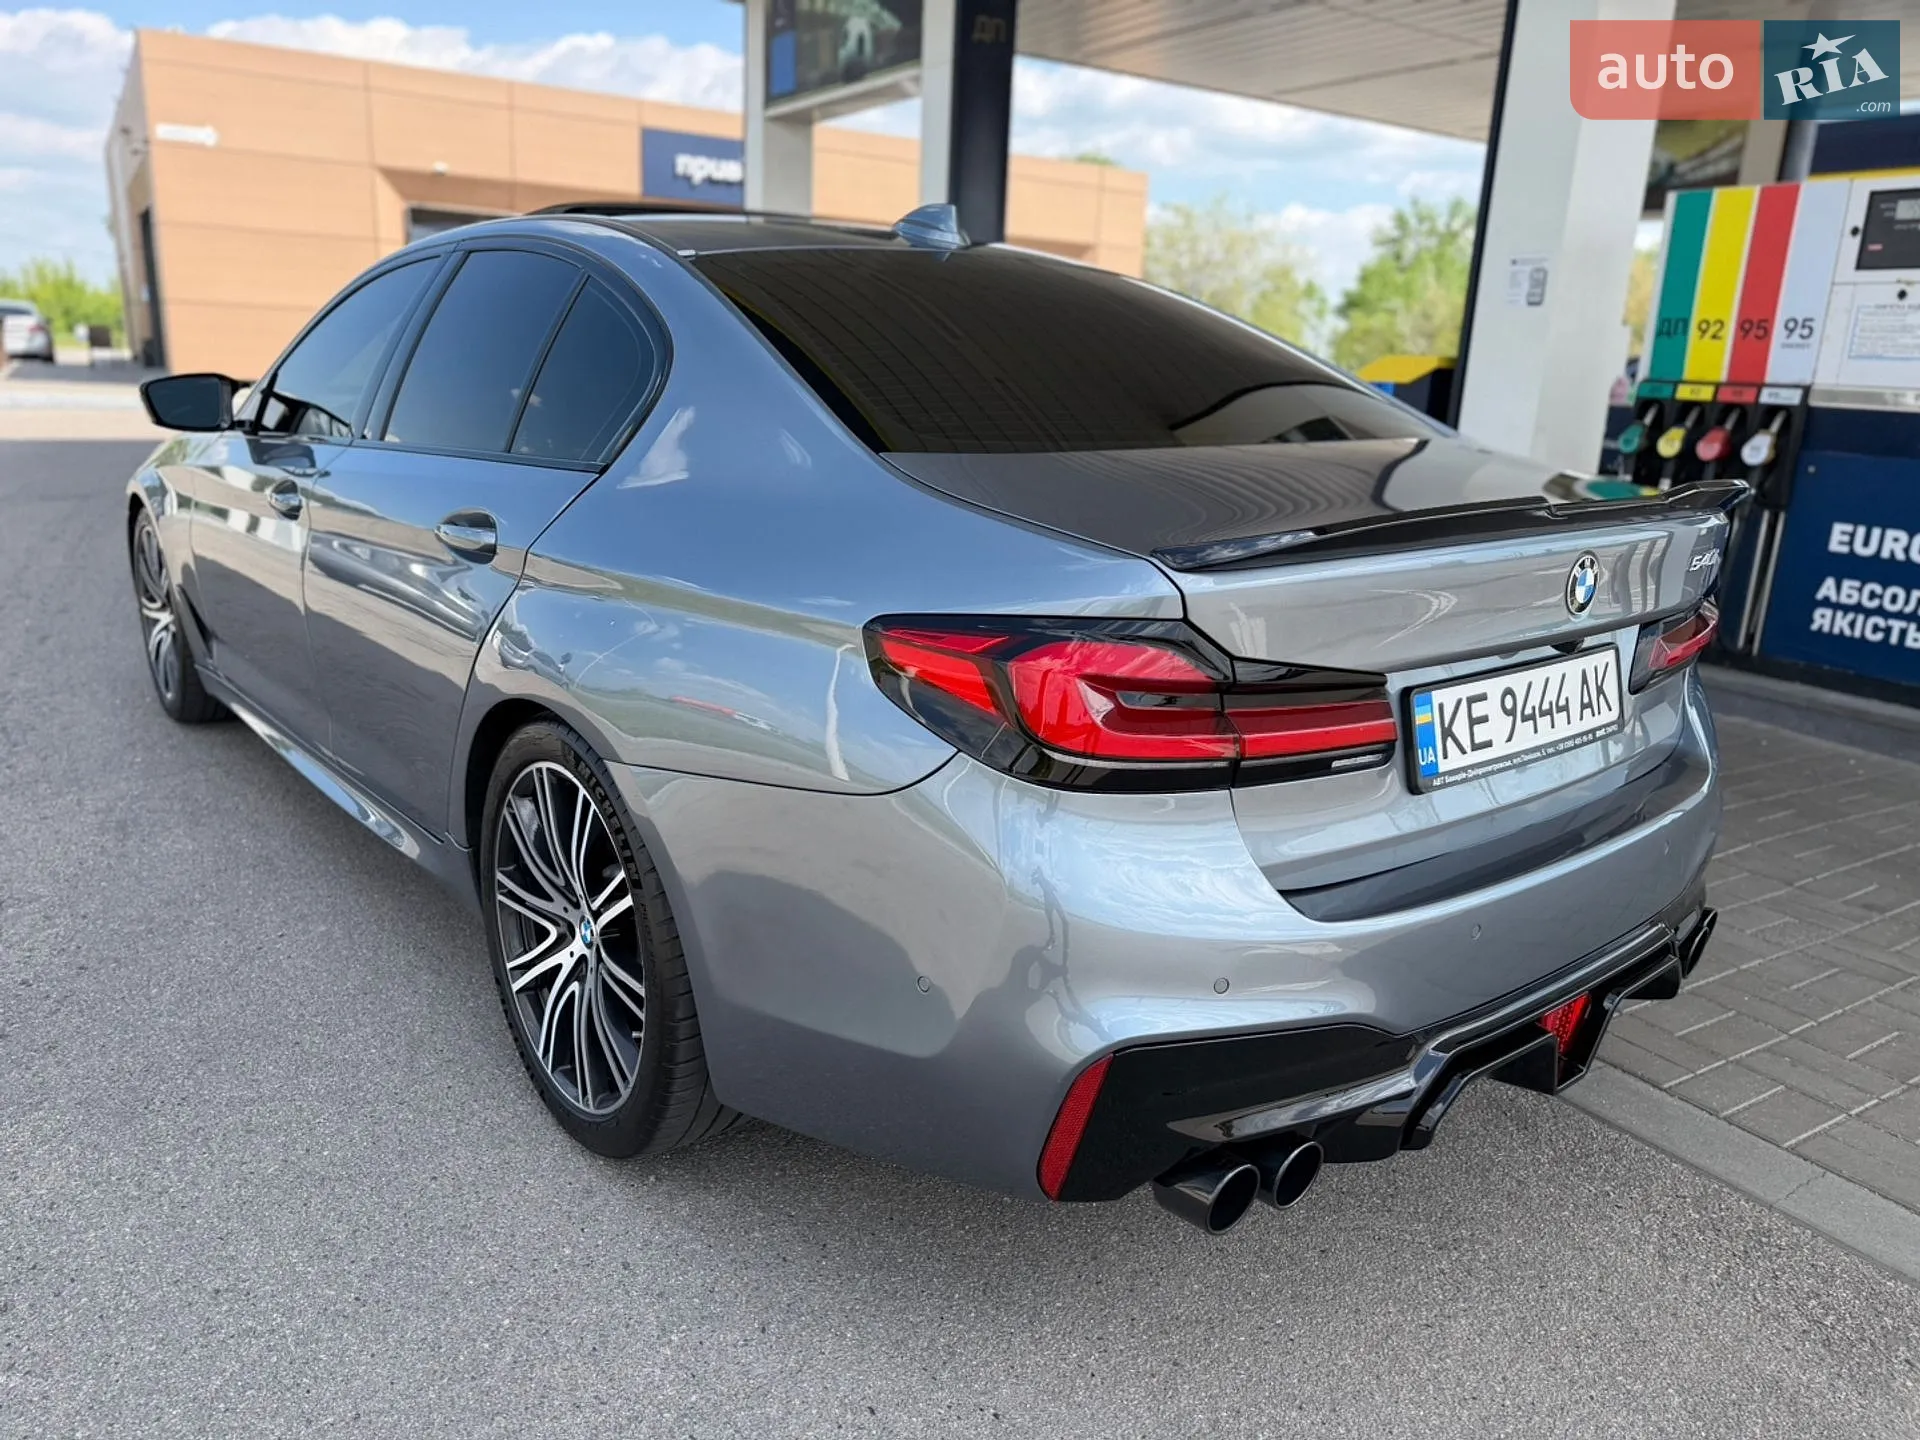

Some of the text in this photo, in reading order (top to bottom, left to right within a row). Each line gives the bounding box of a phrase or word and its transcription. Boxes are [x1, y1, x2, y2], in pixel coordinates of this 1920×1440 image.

[1697, 319, 1726, 341] 92
[1740, 318, 1770, 341] 95
[1783, 317, 1816, 340] 95
[1809, 607, 1920, 650] ЯКІСТЬ
[1438, 692, 1494, 760] KE
[1500, 672, 1572, 743] 9444
[1579, 661, 1613, 722] AK
[1417, 746, 1436, 766] UA
[577, 760, 641, 880] MICHELIN
